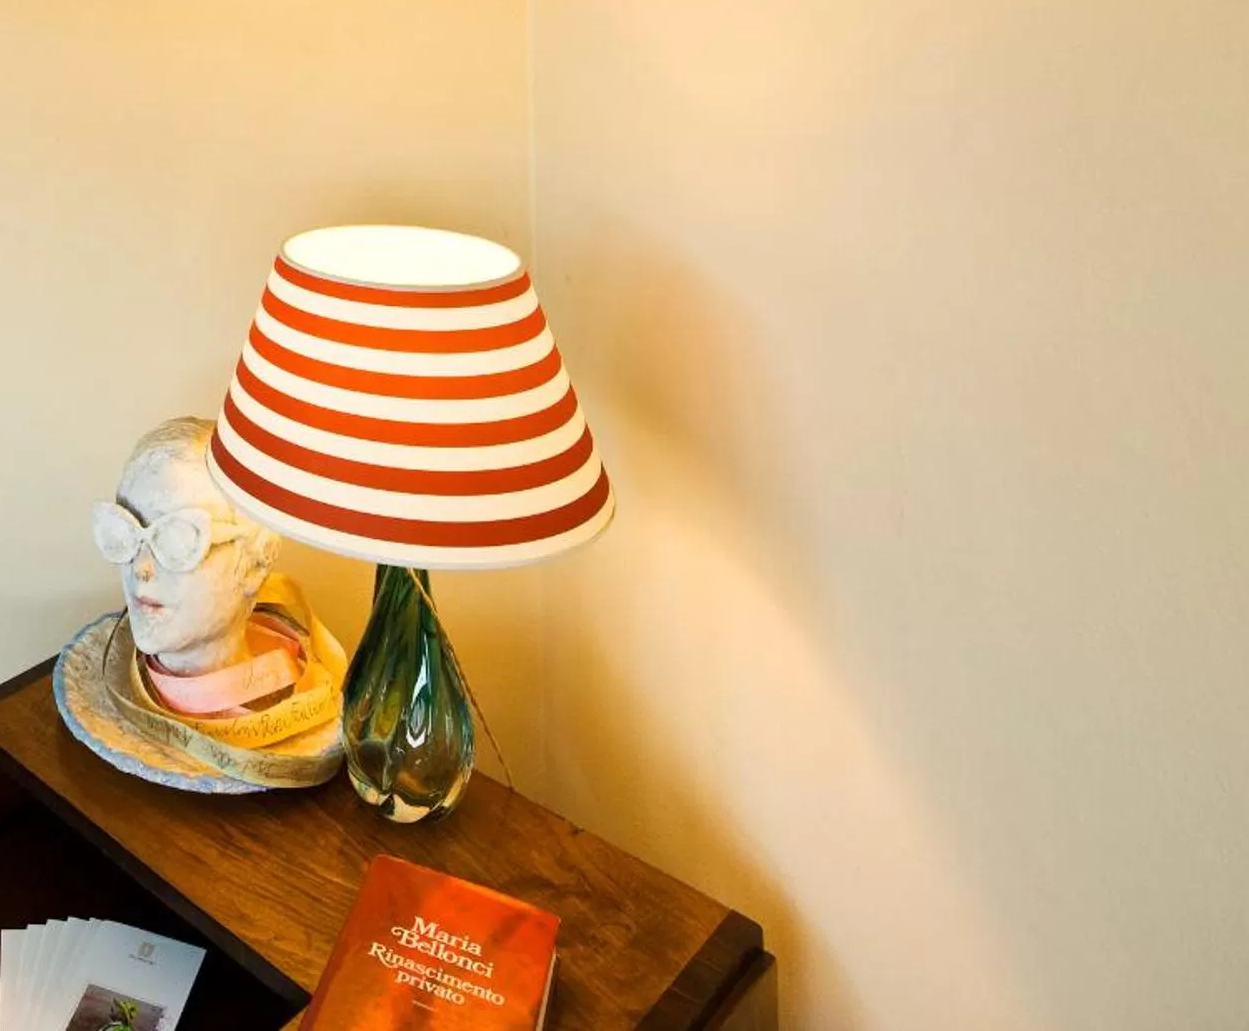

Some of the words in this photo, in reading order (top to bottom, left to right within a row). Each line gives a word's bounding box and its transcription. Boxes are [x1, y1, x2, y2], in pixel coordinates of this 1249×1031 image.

[391, 926, 495, 979] Bellonci
[411, 916, 483, 957] Maria
[367, 942, 506, 1006] Rinascimento
[395, 970, 466, 1006] privato
